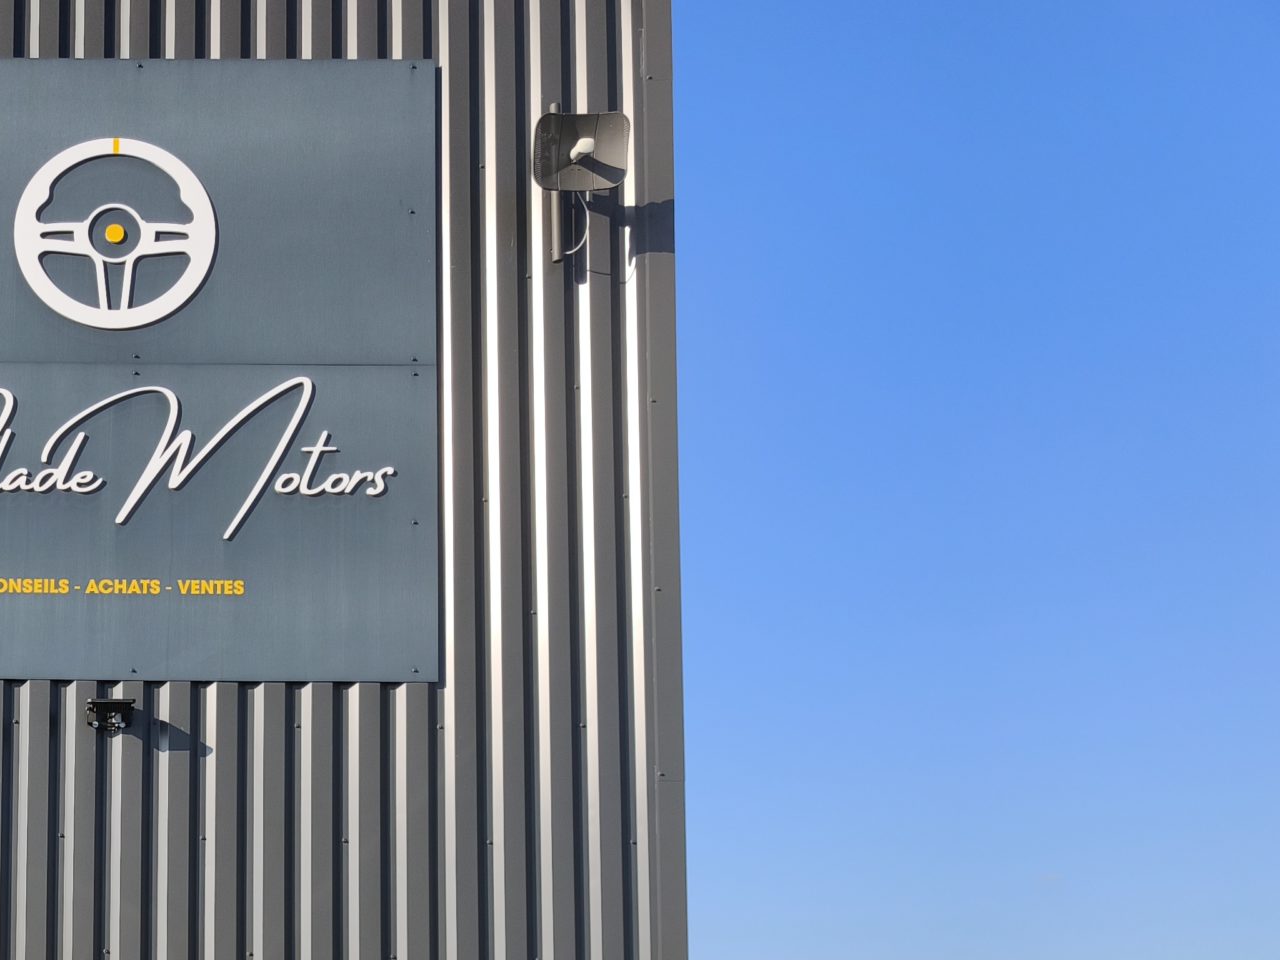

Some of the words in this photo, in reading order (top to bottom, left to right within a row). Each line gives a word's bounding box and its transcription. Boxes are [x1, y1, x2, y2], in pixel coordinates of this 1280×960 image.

[40, 376, 396, 541] Motors
[85, 579, 161, 595] ACHATS
[177, 579, 245, 595] VENTES
